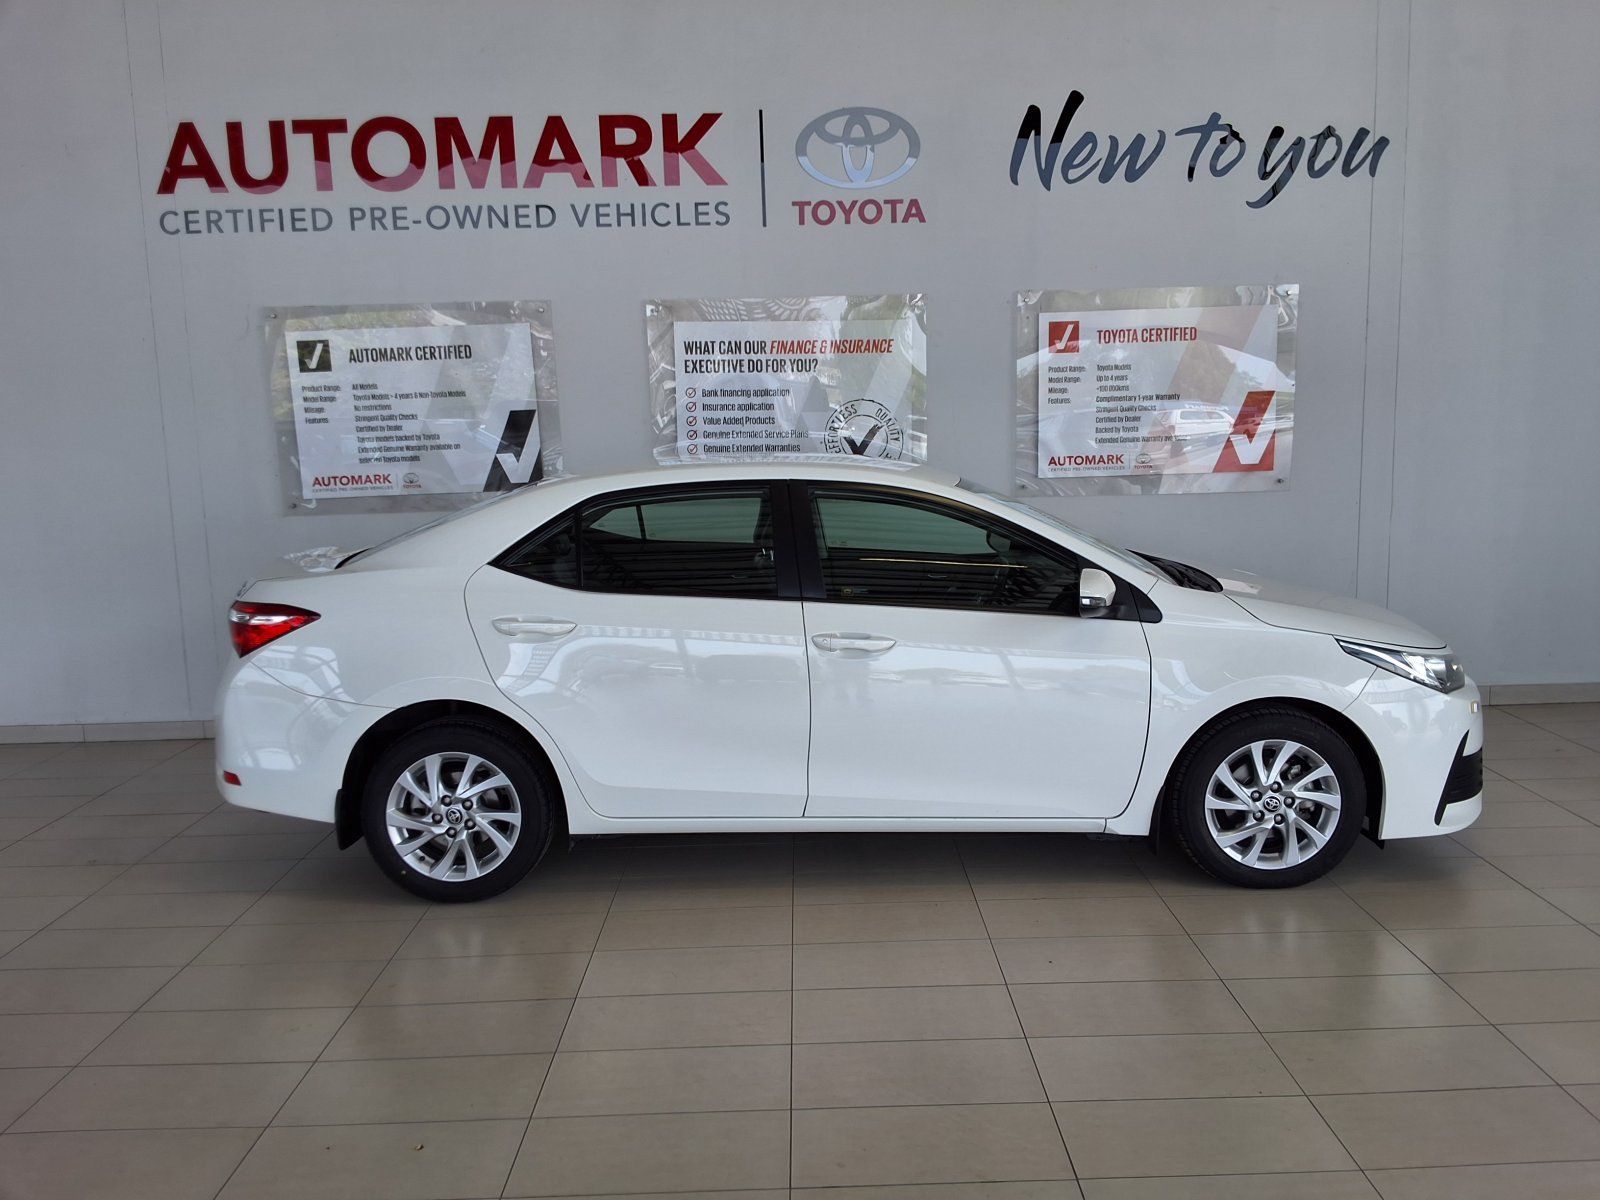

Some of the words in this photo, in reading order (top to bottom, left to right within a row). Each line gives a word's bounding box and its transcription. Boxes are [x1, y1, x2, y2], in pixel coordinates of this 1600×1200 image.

[157, 112, 728, 195] AUTOMARK
[1009, 89, 1166, 191] New
[1175, 111, 1246, 183] to
[1245, 124, 1390, 209] you
[791, 198, 926, 226] TOYOTA
[159, 206, 333, 235] CERTIFIED
[350, 204, 557, 232] PRE-OWNED
[570, 201, 731, 228] VEHICLES
[1097, 329, 1138, 344] TOYOTA
[1141, 327, 1197, 343] CERTIFIED
[684, 341, 715, 355] WHAT
[719, 340, 742, 355] CAN
[744, 340, 767, 355] OUR
[770, 339, 818, 354] FINANCE
[829, 338, 894, 354] INSURANCE
[348, 346, 413, 363] AUTOMARK
[415, 344, 472, 360] CERTIFIED
[684, 359, 745, 374] EXECUTIVE
[747, 359, 763, 373] DO
[765, 358, 786, 373] FOR
[789, 358, 819, 373] YOU?
[1097, 364, 1113, 372] Toyota
[1113, 363, 1131, 371] Models
[360, 382, 378, 390] Models
[399, 392, 413, 400] years
[419, 391, 447, 399] Non-Toyota
[447, 390, 466, 398] Models
[702, 388, 719, 397] Bank
[720, 388, 752, 398] financing
[752, 388, 790, 398] application
[1096, 394, 1136, 403] Complimentary
[1155, 393, 1180, 401] Warranty
[362, 403, 392, 411] restrictions
[702, 403, 736, 411] Insurance
[736, 402, 775, 412] application
[1138, 404, 1156, 412] Checks
[355, 414, 379, 422] Stringent
[380, 413, 398, 421] Quality
[702, 416, 721, 425] Value
[723, 416, 744, 425] Added
[745, 415, 775, 425] Products
[356, 424, 378, 432] Certified
[875, 408, 900, 442] QUALITY
[395, 434, 414, 442] backed
[422, 433, 440, 441] Toyota
[703, 430, 730, 439] Genuine
[731, 430, 763, 439] Extended
[764, 430, 789, 439] Service
[790, 429, 809, 438] Plans
[1141, 435, 1163, 443] Warranty
[405, 444, 429, 452] Warranty
[703, 444, 730, 453] Genuine
[731, 444, 763, 453] Extended
[765, 443, 801, 453] Warranties
[1048, 453, 1124, 466] AUTOMARK
[312, 474, 392, 487] AUTOMARK
